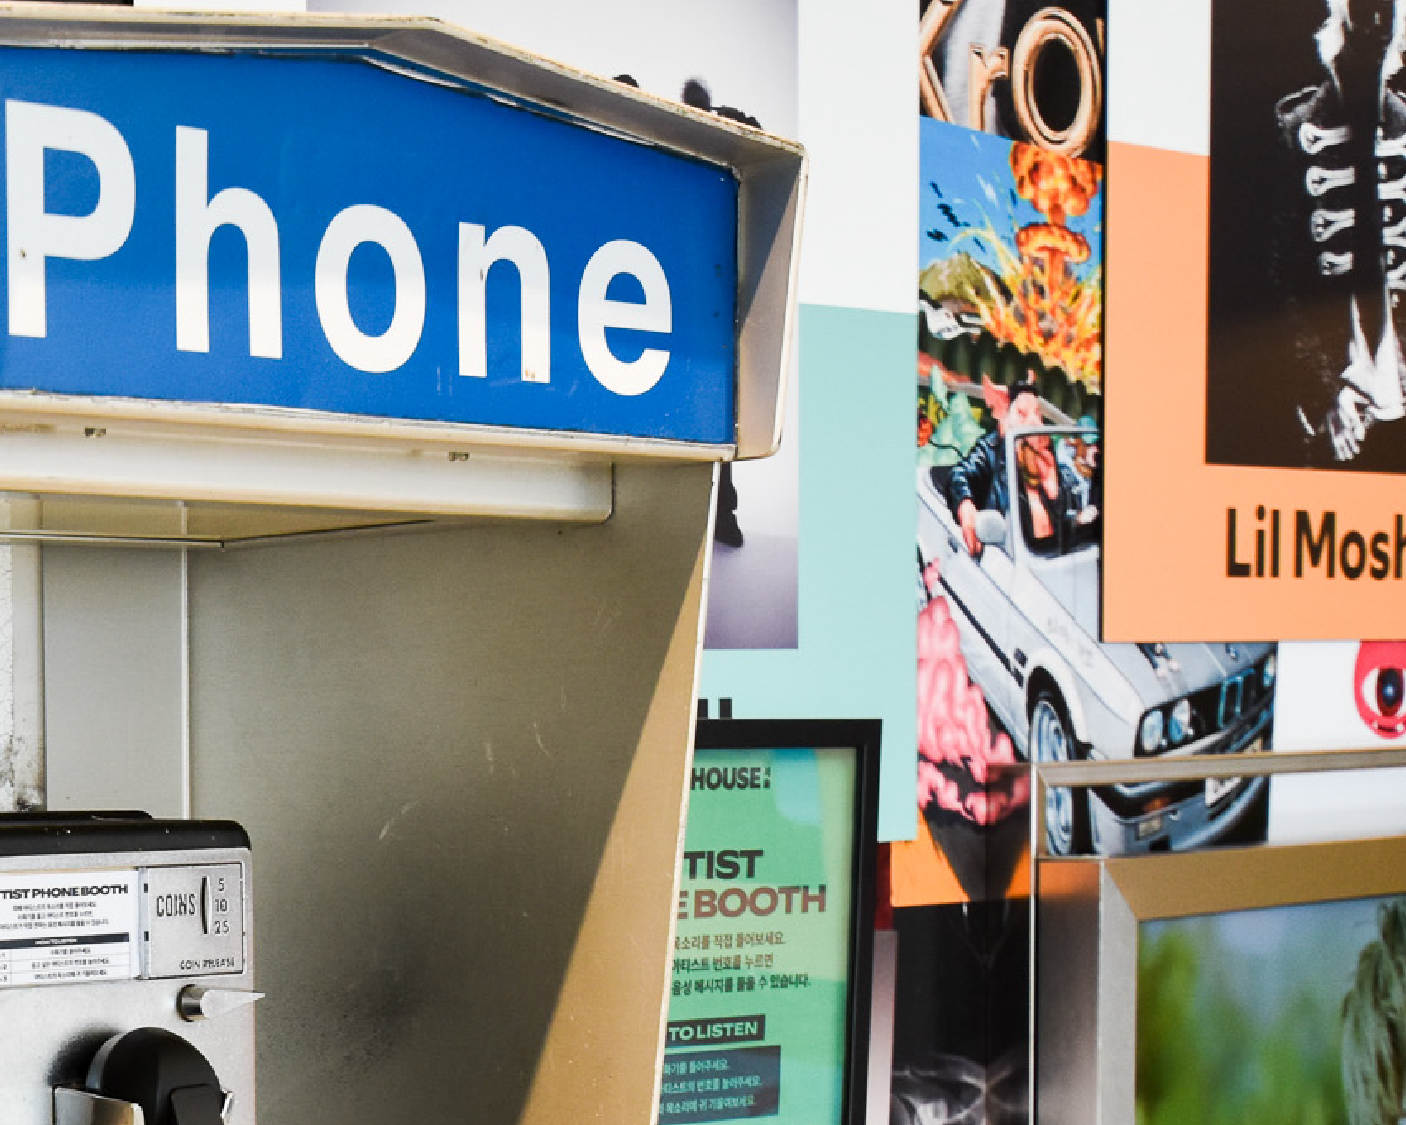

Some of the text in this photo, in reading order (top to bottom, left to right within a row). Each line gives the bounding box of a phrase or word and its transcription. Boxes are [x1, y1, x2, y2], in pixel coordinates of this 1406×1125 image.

[6, 98, 673, 397] Phone
[1225, 504, 1406, 581] Lil Mosh
[32, 886, 81, 899] PHONE
[81, 883, 129, 896] BOOTH
[218, 877, 225, 892] 5
[156, 893, 196, 918] COINS
[215, 898, 227, 912] 10
[693, 883, 827, 918] BOOTH
[214, 920, 230, 934] 25
[668, 1021, 759, 1041] TO LISTEN
